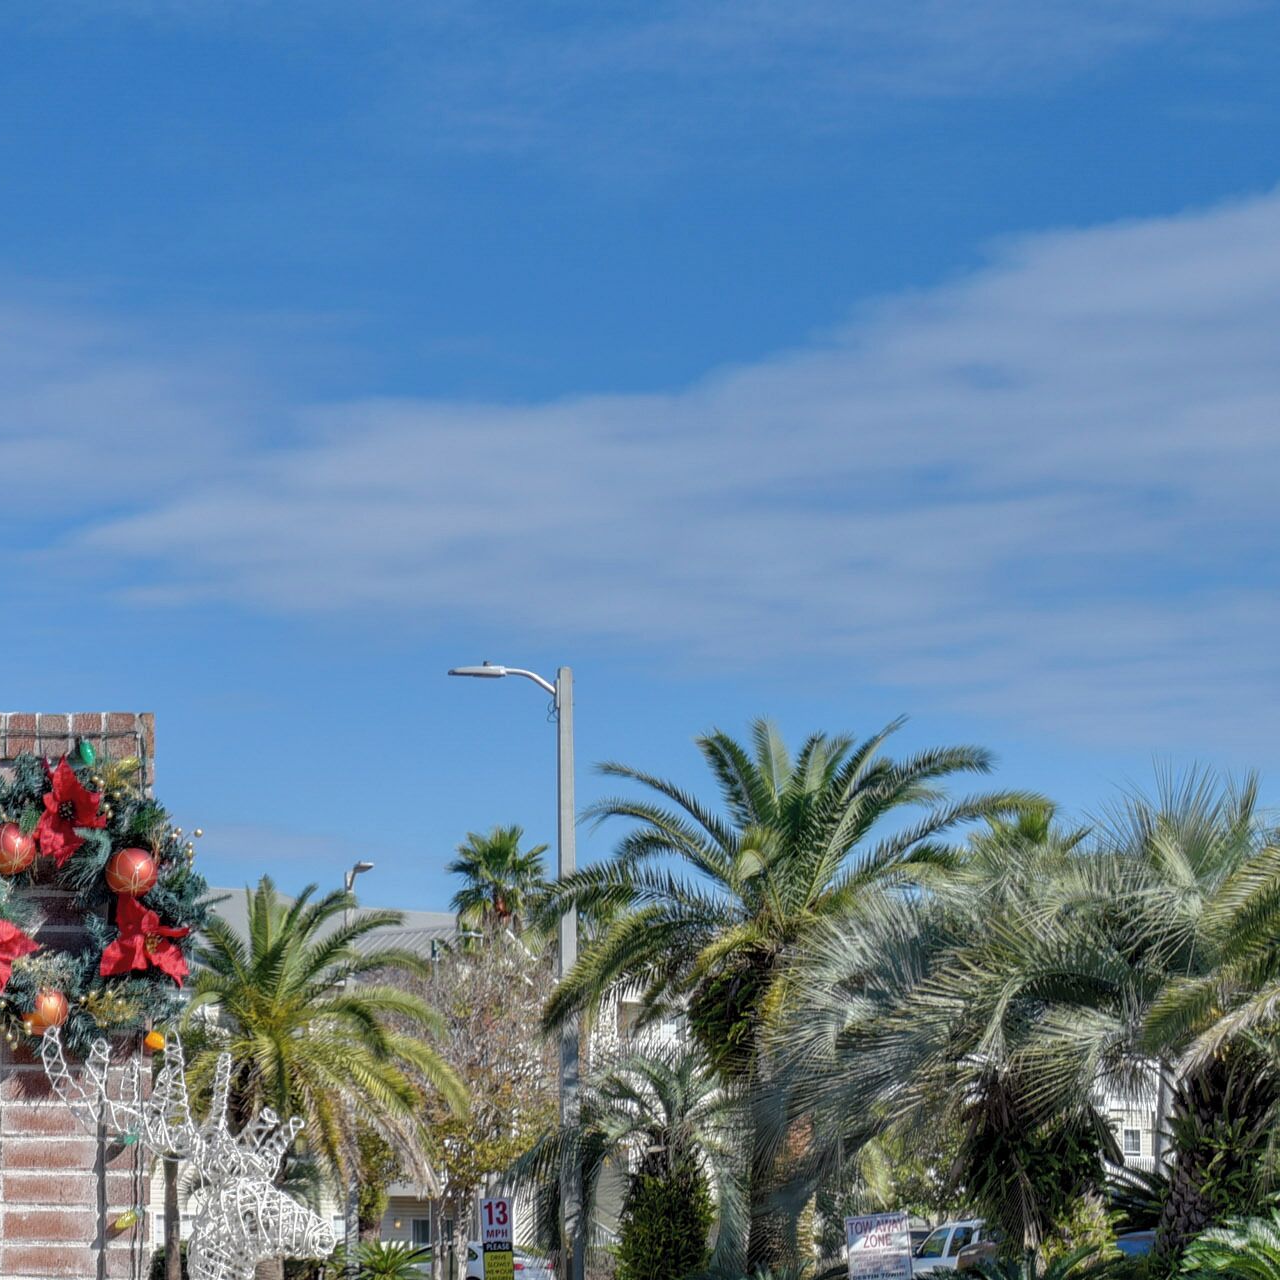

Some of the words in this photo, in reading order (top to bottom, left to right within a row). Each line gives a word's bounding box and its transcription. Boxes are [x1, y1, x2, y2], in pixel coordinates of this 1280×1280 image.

[484, 1201, 508, 1226] 13
[486, 1229, 508, 1239] MPH
[848, 1220, 873, 1236] TOW
[876, 1217, 904, 1233] AWAY
[486, 1242, 510, 1251] PLEASE
[864, 1233, 893, 1248] ZONE
